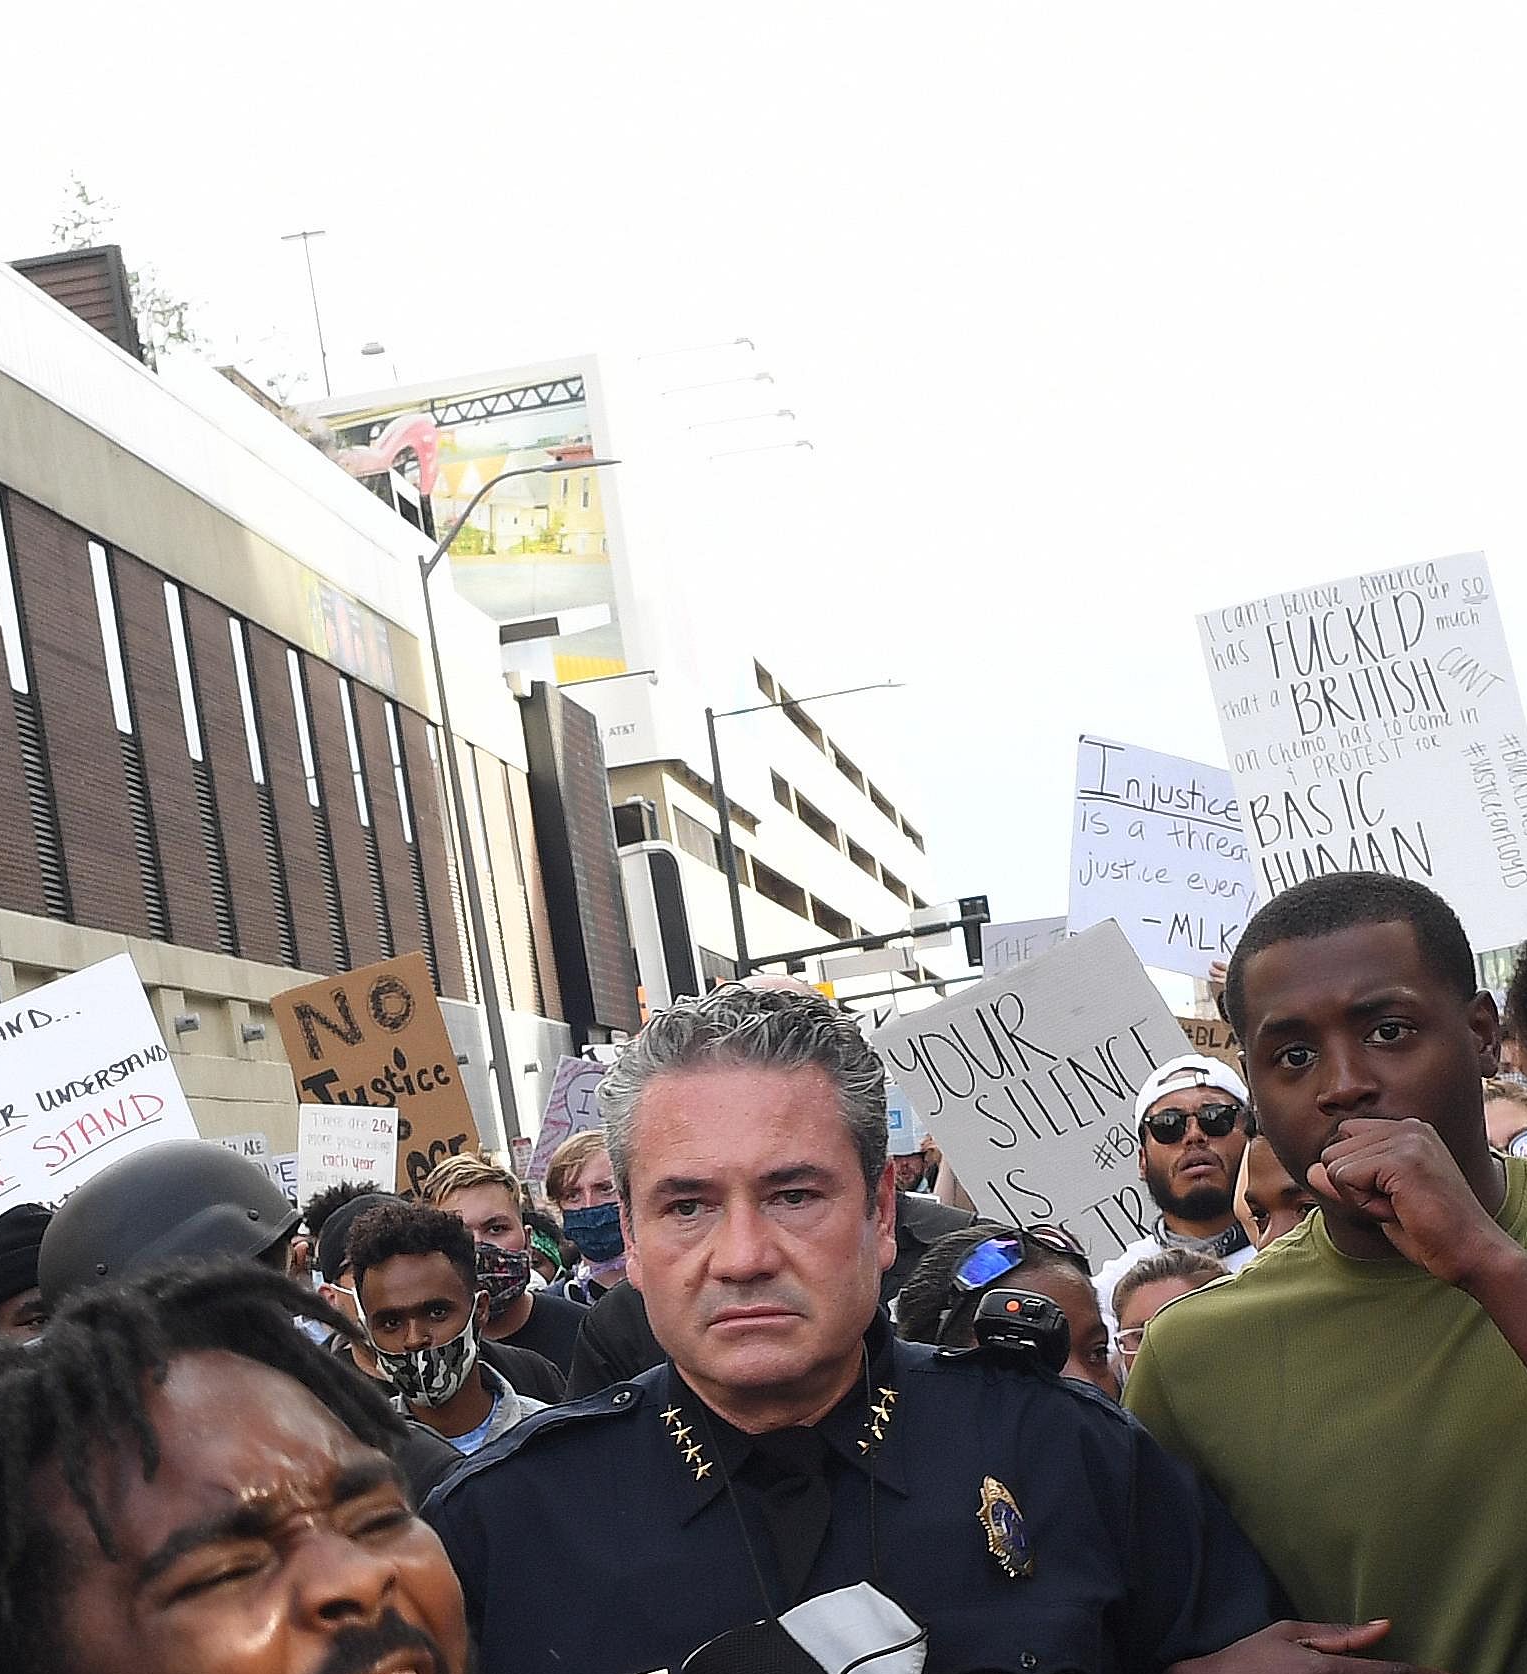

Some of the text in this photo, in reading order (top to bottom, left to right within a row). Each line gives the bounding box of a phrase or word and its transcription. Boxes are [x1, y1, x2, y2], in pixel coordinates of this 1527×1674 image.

[1203, 614, 1217, 642] I
[1280, 585, 1343, 618] believe
[1210, 638, 1251, 672] has
[1266, 590, 1425, 680] FUCKED
[1428, 581, 1450, 600] up
[1435, 607, 1481, 631] much
[1221, 657, 1448, 737] that a BRITISH
[1435, 646, 1505, 698] CUNT
[1234, 748, 1262, 775] on
[1336, 722, 1373, 750] has
[1383, 718, 1403, 738] to
[1408, 712, 1453, 732] come
[1459, 706, 1480, 725] in
[1312, 737, 1405, 778] PROTEST
[1079, 739, 1242, 823] Injustice
[1249, 770, 1386, 849] BASIC
[1080, 802, 1251, 863] is a threa
[1078, 851, 1172, 887] justice
[292, 973, 416, 1061] NO
[35, 1043, 169, 1113] UNDERSTAND
[887, 992, 1058, 1117] YOUR
[32, 1093, 165, 1169] STAND
[321, 1153, 377, 1173] each year
[987, 1168, 1054, 1228] IS
